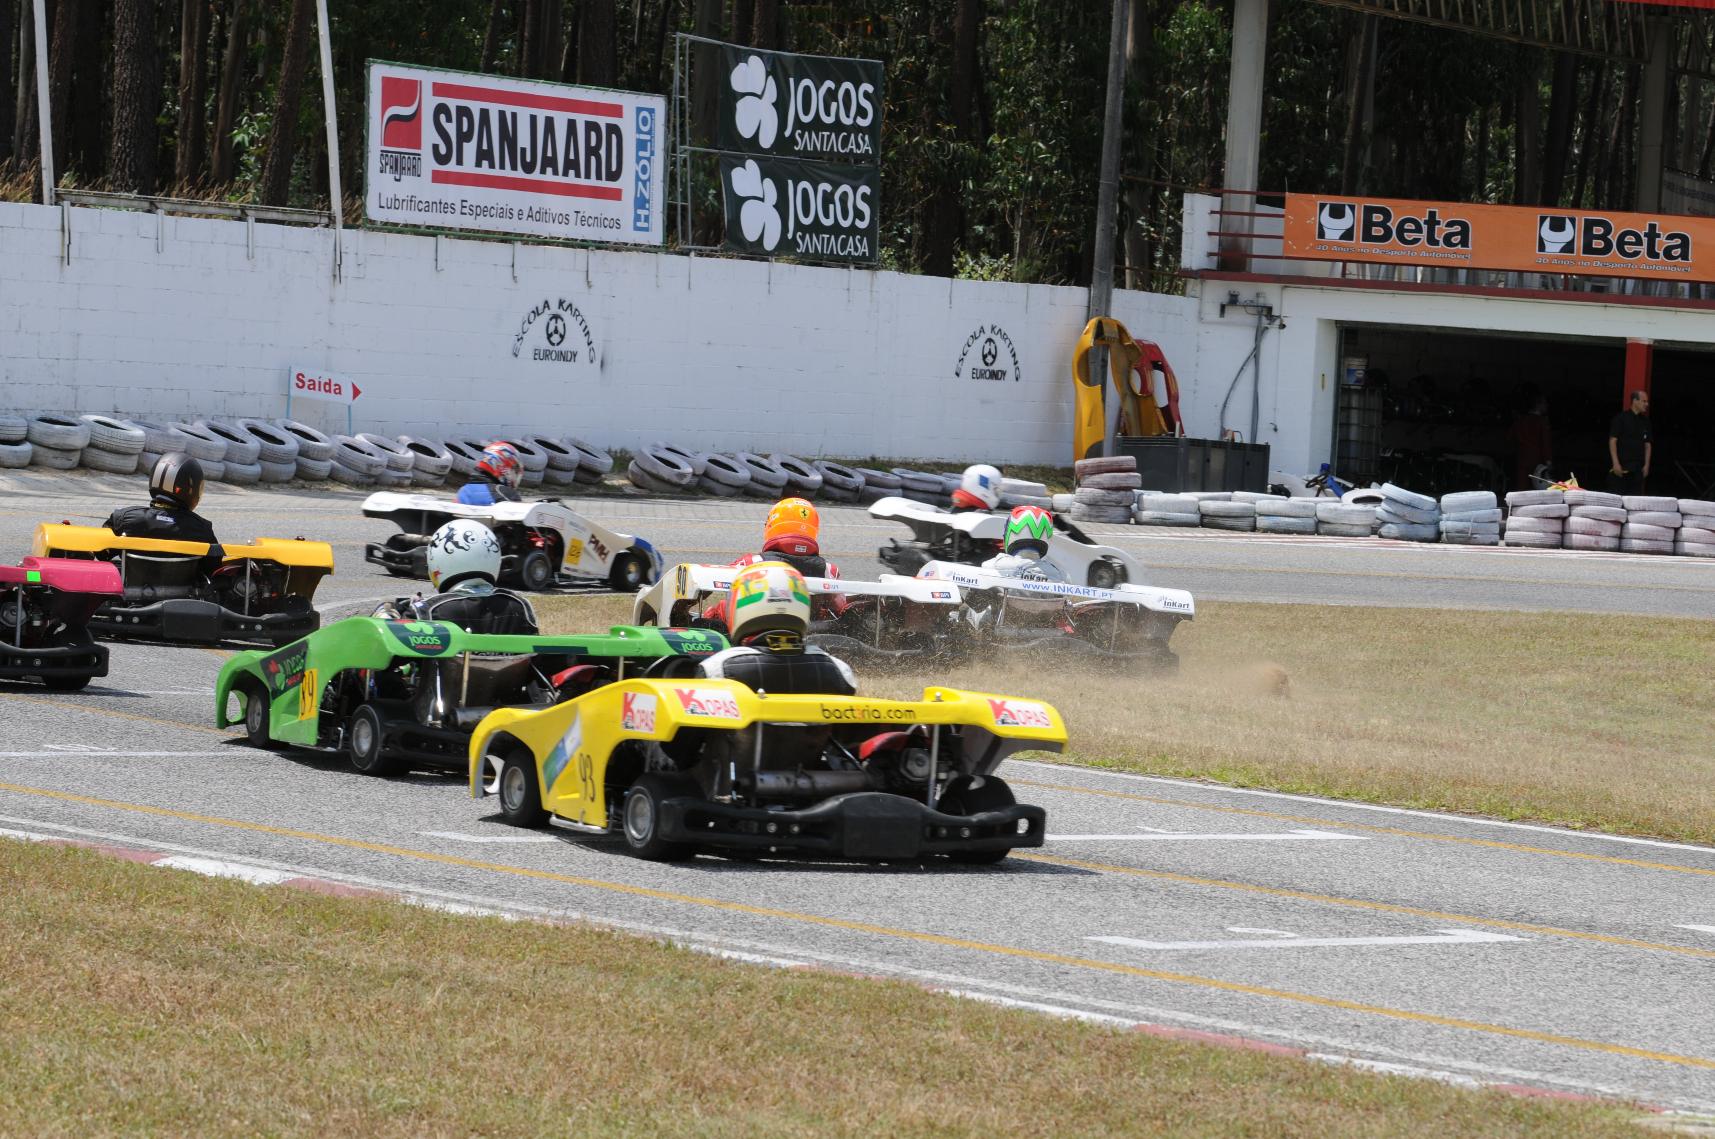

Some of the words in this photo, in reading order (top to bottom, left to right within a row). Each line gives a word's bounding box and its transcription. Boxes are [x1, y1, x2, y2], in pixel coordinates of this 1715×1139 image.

[784, 77, 874, 138] JOGOS
[432, 102, 624, 182] SPANJAARD
[794, 130, 872, 154] SANTACASA
[379, 152, 421, 182] SPANJAARD
[378, 192, 456, 215] Lubrificantes
[460, 199, 514, 220] Especiais
[517, 209, 524, 221] e
[526, 206, 570, 226] Aditivos
[574, 210, 621, 230] Técnicos
[787, 179, 871, 239] JOGOS
[1360, 204, 1472, 250] Beta
[1581, 217, 1692, 262] Beta
[796, 232, 869, 257] SANTACASA
[1372, 247, 1417, 257] Desporto
[1592, 260, 1637, 270] Desporto
[513, 300, 551, 358] ESCOLA
[557, 299, 596, 364] KARTING
[533, 348, 578, 363] EUROINDY
[955, 325, 986, 378] ESCOLA
[990, 324, 1021, 382] KARTING
[295, 372, 343, 396] Saída
[971, 367, 1007, 381] EUROINDY
[1021, 582, 1114, 599] www.INKART.PT
[408, 636, 441, 647] JOGOS
[681, 643, 713, 653] JOGOS
[579, 752, 596, 803] 93
